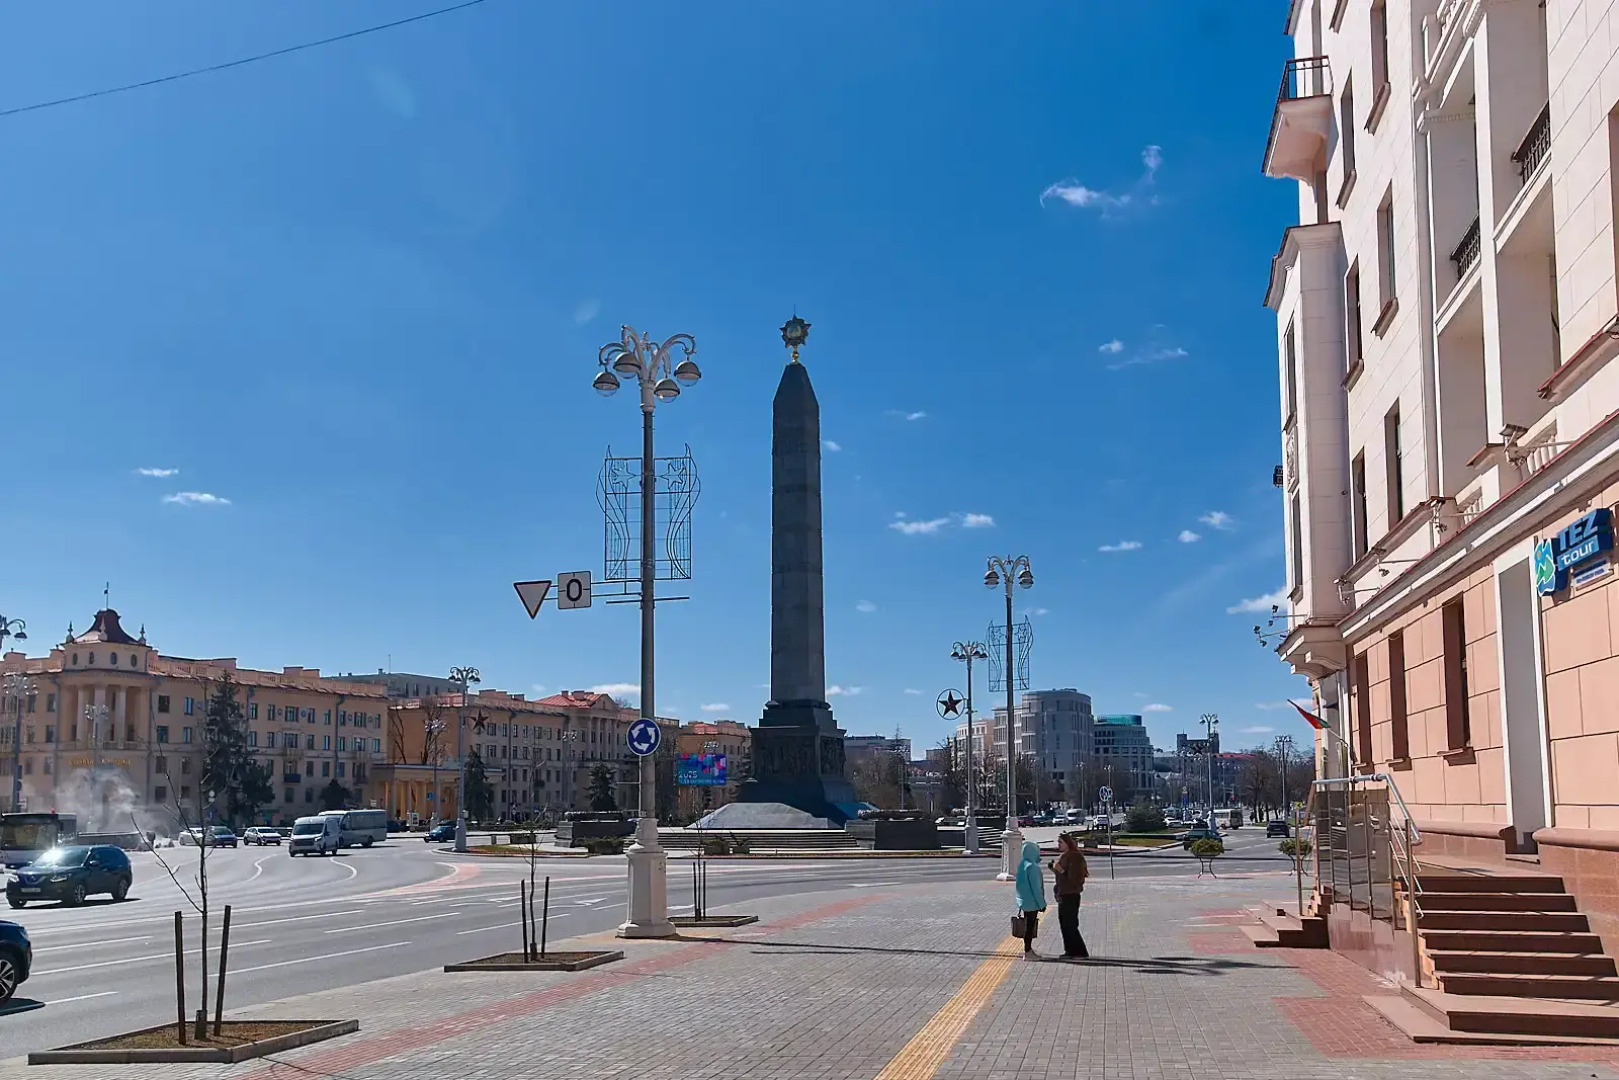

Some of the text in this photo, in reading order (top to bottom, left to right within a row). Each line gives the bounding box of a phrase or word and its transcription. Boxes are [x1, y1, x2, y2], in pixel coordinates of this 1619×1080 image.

[1557, 509, 1598, 551] TEZ
[1561, 540, 1594, 566] tour
[678, 770, 698, 779] 2025
